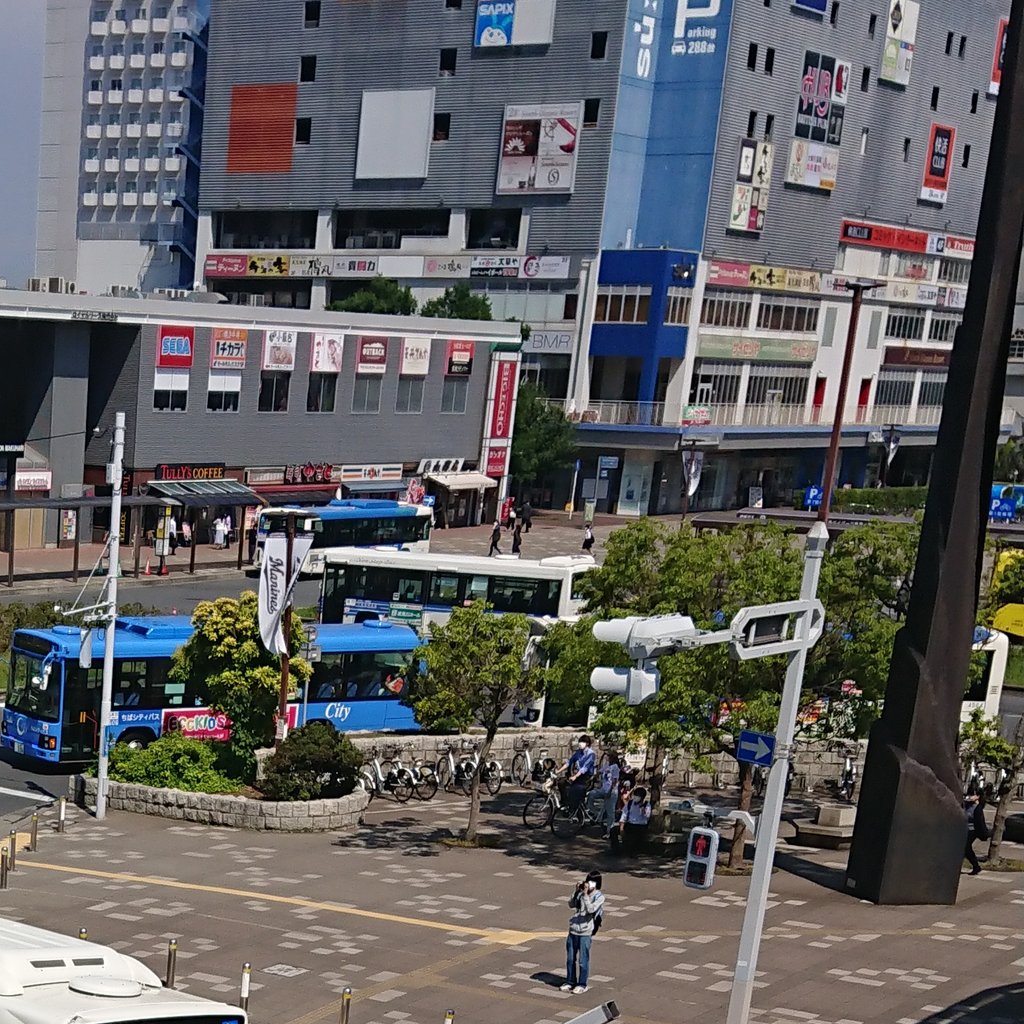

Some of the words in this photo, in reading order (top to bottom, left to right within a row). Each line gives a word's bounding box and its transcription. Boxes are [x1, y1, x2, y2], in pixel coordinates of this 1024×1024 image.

[479, 3, 514, 15] SAPIX
[161, 336, 191, 356] SEGA
[362, 347, 385, 356] OUTBACK
[161, 465, 192, 479] TULLY'S
[193, 467, 224, 478] COFFEE
[267, 555, 284, 615] Marines
[121, 712, 161, 722] ちばシティバス
[325, 702, 351, 720] City
